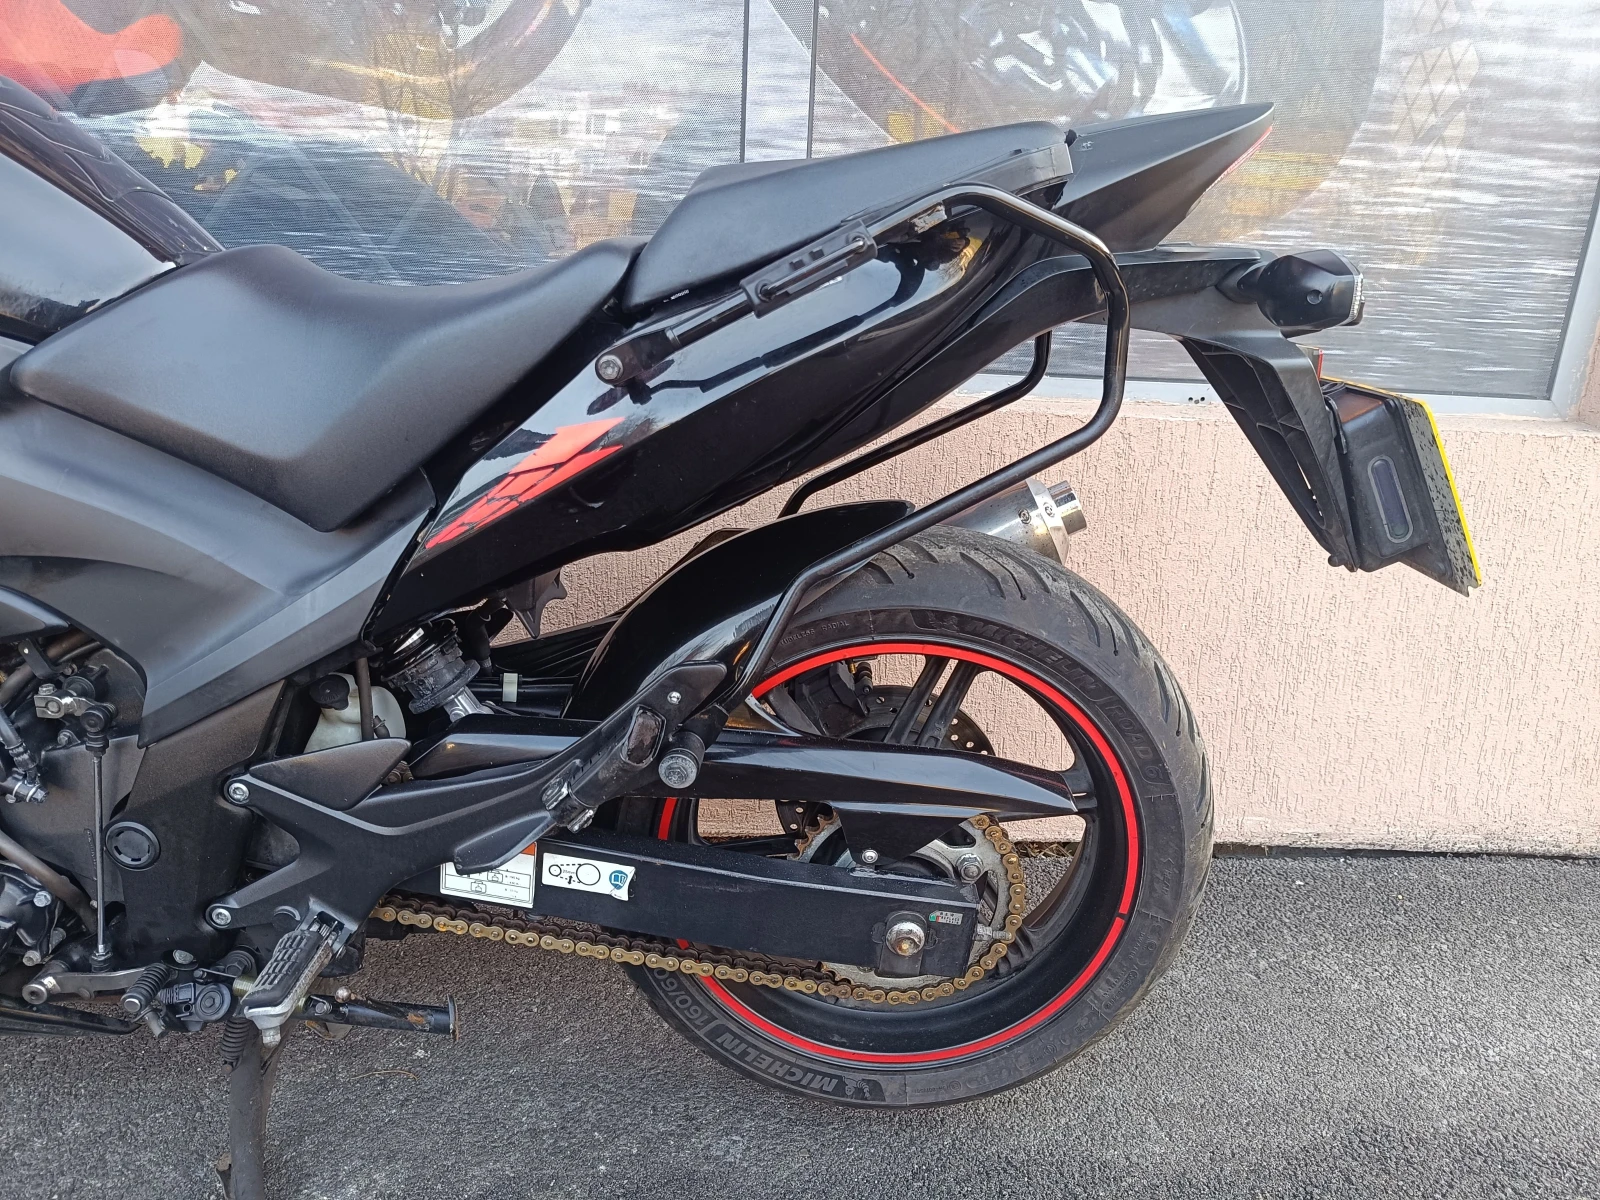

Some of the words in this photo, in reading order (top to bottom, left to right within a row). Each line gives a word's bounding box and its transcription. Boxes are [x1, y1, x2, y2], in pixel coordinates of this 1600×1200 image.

[821, 620, 850, 631] RADIAL
[965, 620, 1101, 691] MICHELIN
[1104, 704, 1154, 760] ROAD
[653, 968, 709, 1026] 160/60
[715, 1031, 839, 1093] MICHELIN
